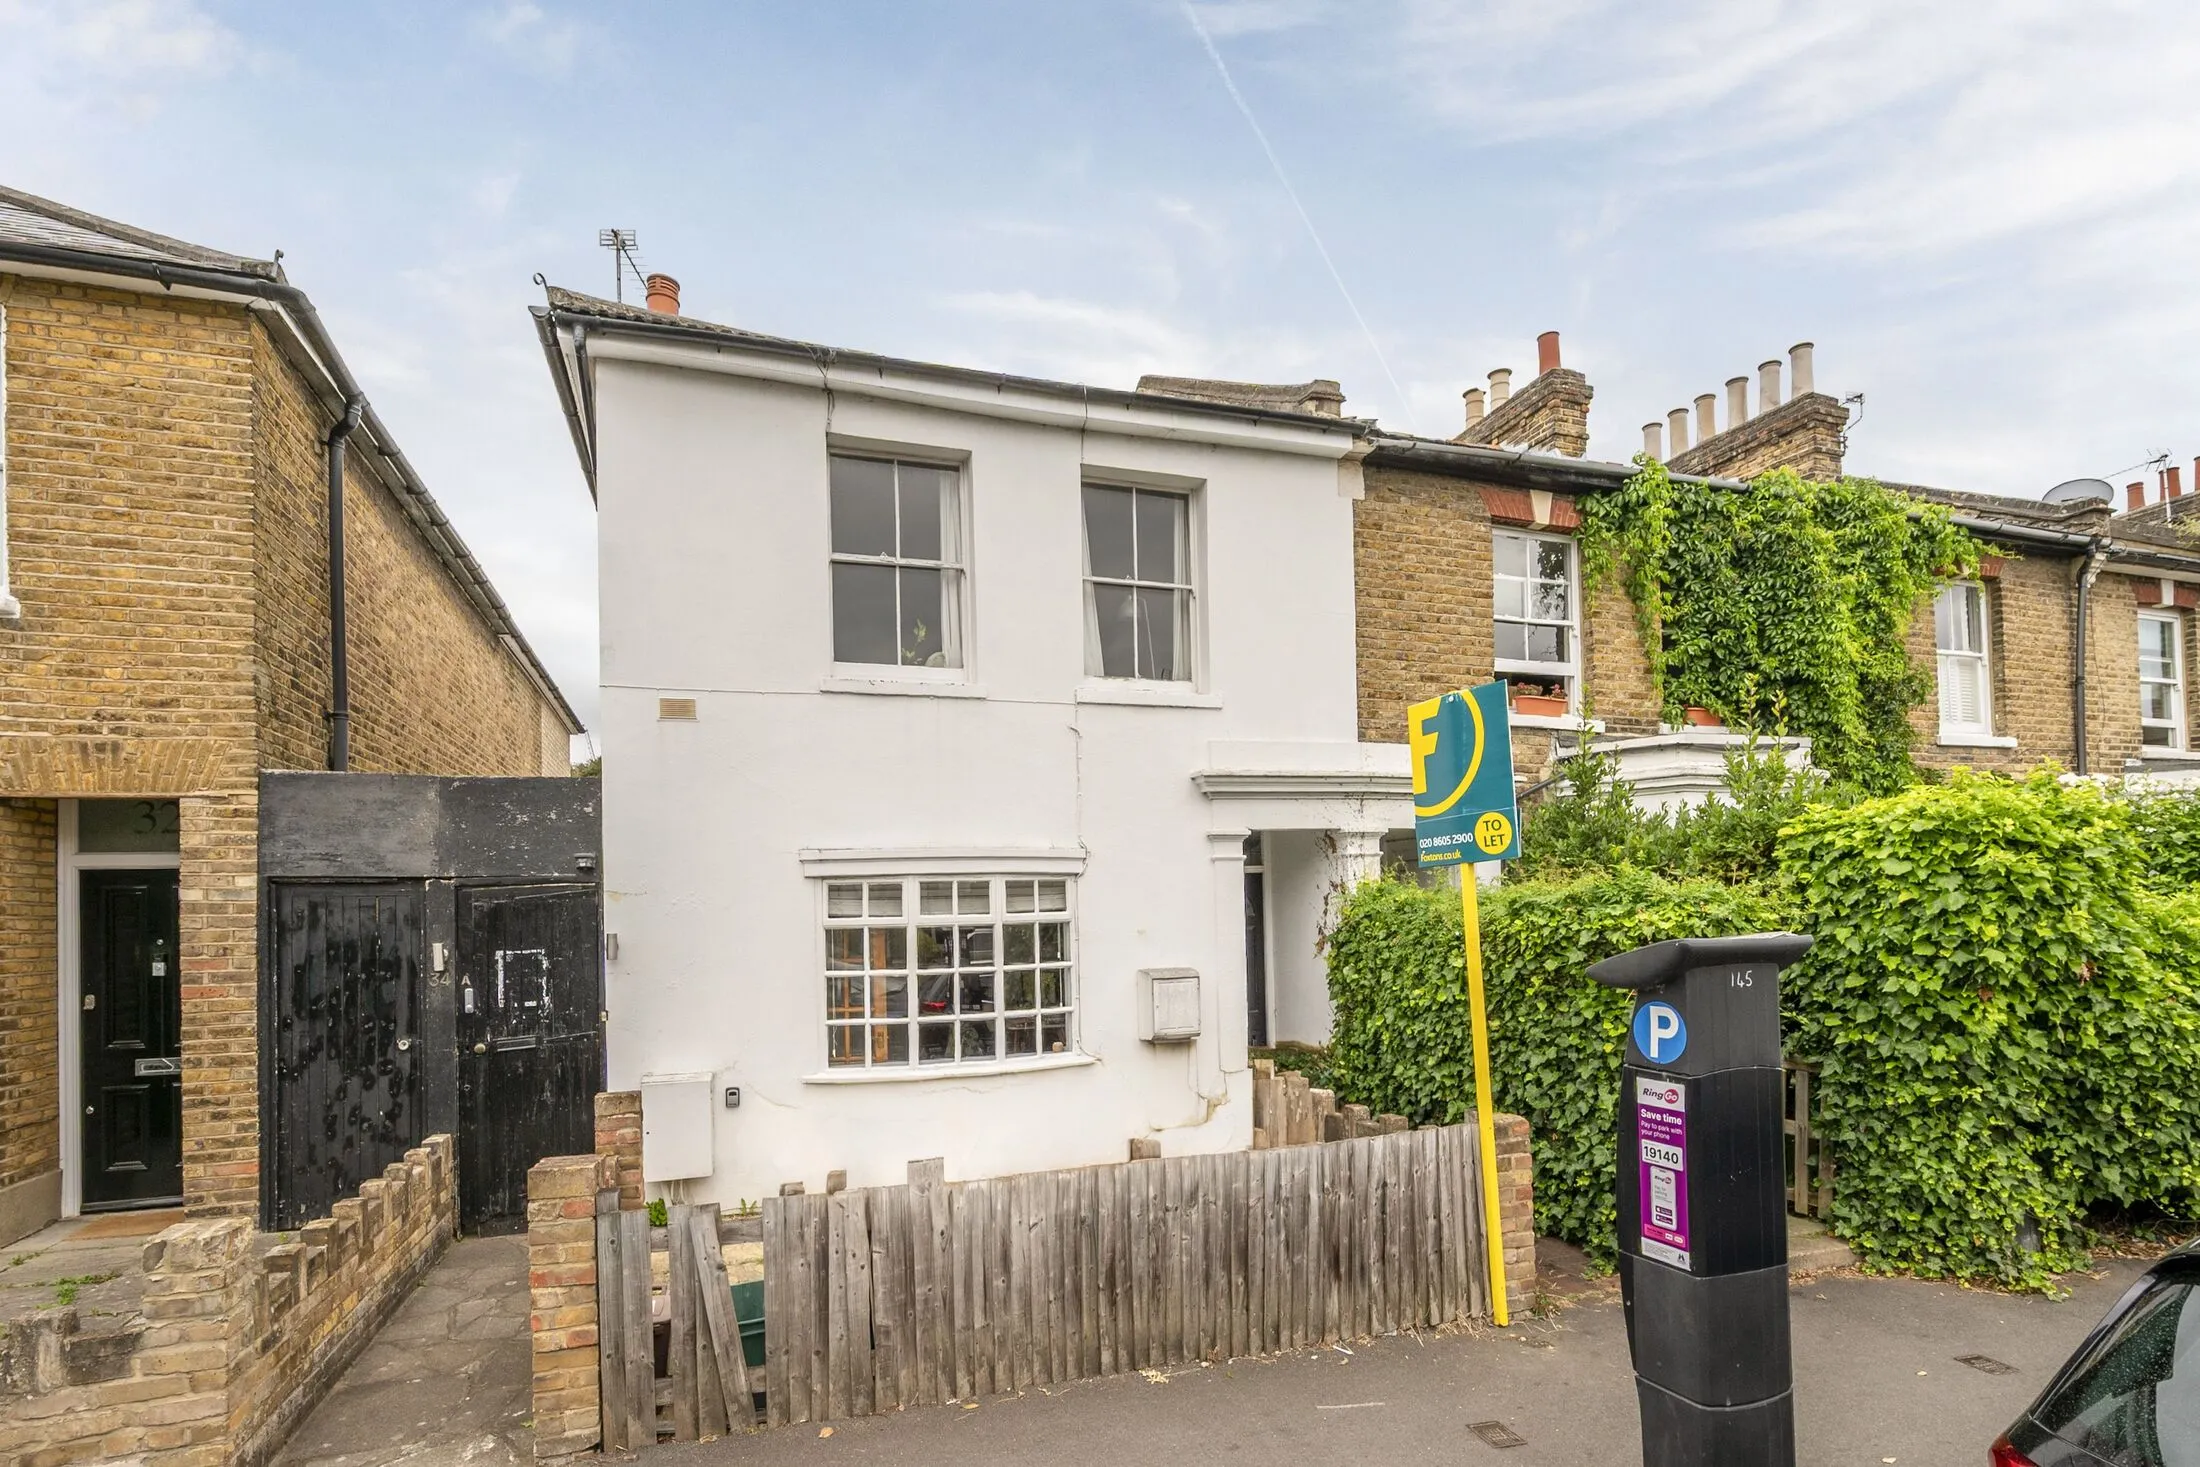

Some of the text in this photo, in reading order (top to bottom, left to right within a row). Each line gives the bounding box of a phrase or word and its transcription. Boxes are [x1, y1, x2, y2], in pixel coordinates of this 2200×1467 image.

[1483, 820, 1502, 831] TO
[1420, 832, 1474, 848] 020 8605 2900
[1484, 834, 1505, 847] LET
[428, 972, 451, 987] 34
[461, 975, 471, 986] A
[1731, 970, 1753, 988] 145
[1649, 1005, 1679, 1058] P
[1640, 1109, 1682, 1125] Save time
[1640, 1120, 1651, 1129] Pay
[1658, 1125, 1670, 1133] park
[1671, 1127, 1682, 1135] with
[1653, 1131, 1670, 1140] phone
[1643, 1146, 1679, 1164] 19140
